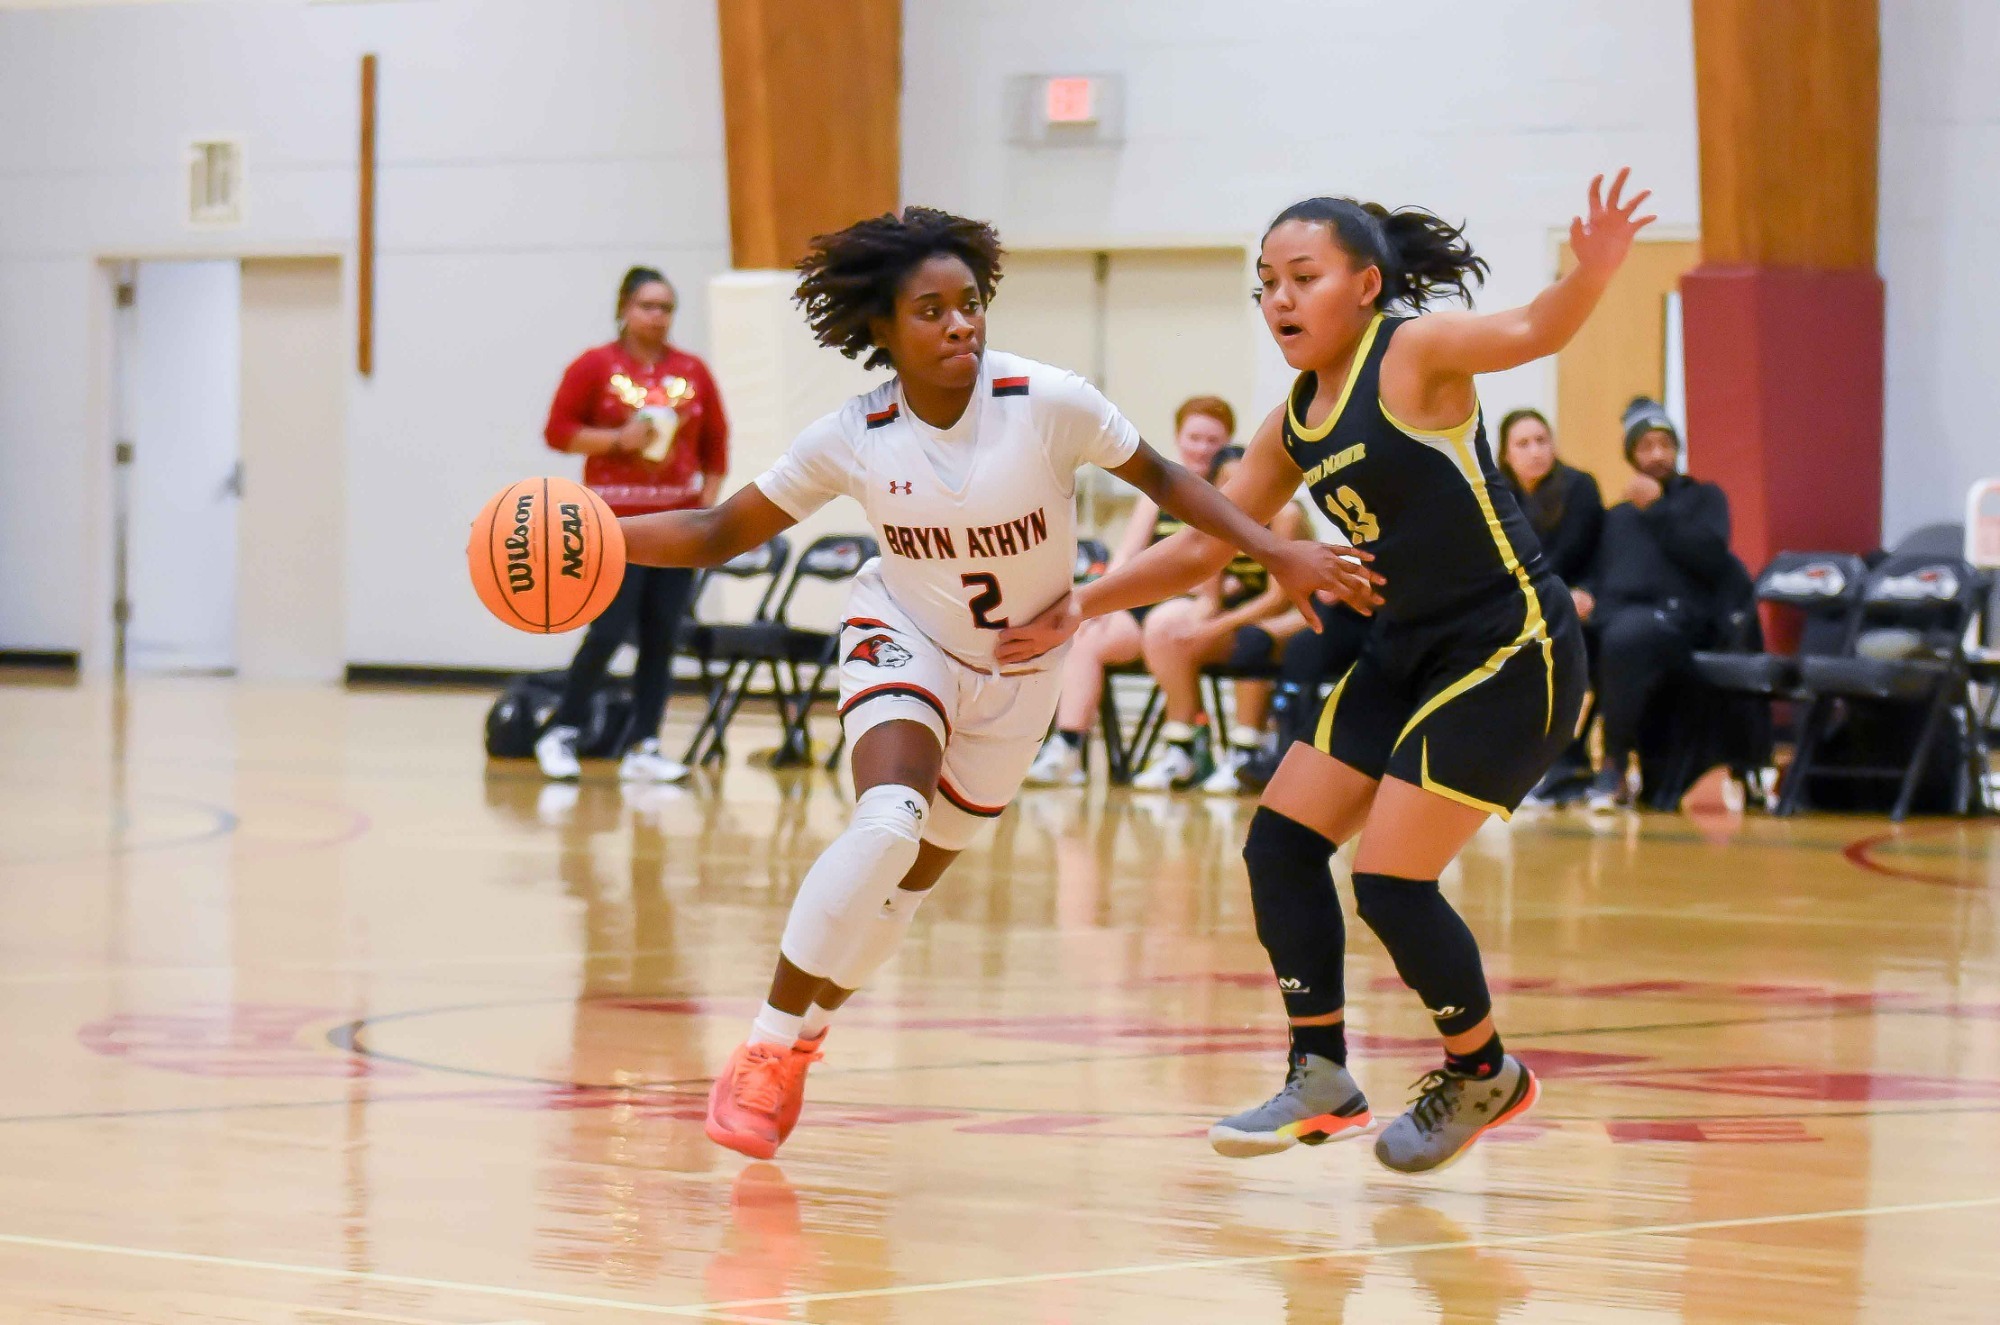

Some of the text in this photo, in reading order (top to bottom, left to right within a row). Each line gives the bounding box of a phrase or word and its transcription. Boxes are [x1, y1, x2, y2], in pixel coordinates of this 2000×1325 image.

[504, 494, 535, 595] Wilson
[560, 503, 584, 580] NCAA
[882, 507, 1048, 560] BRYN ATHYN
[1324, 484, 1381, 546] 13
[960, 571, 1009, 629] 2
